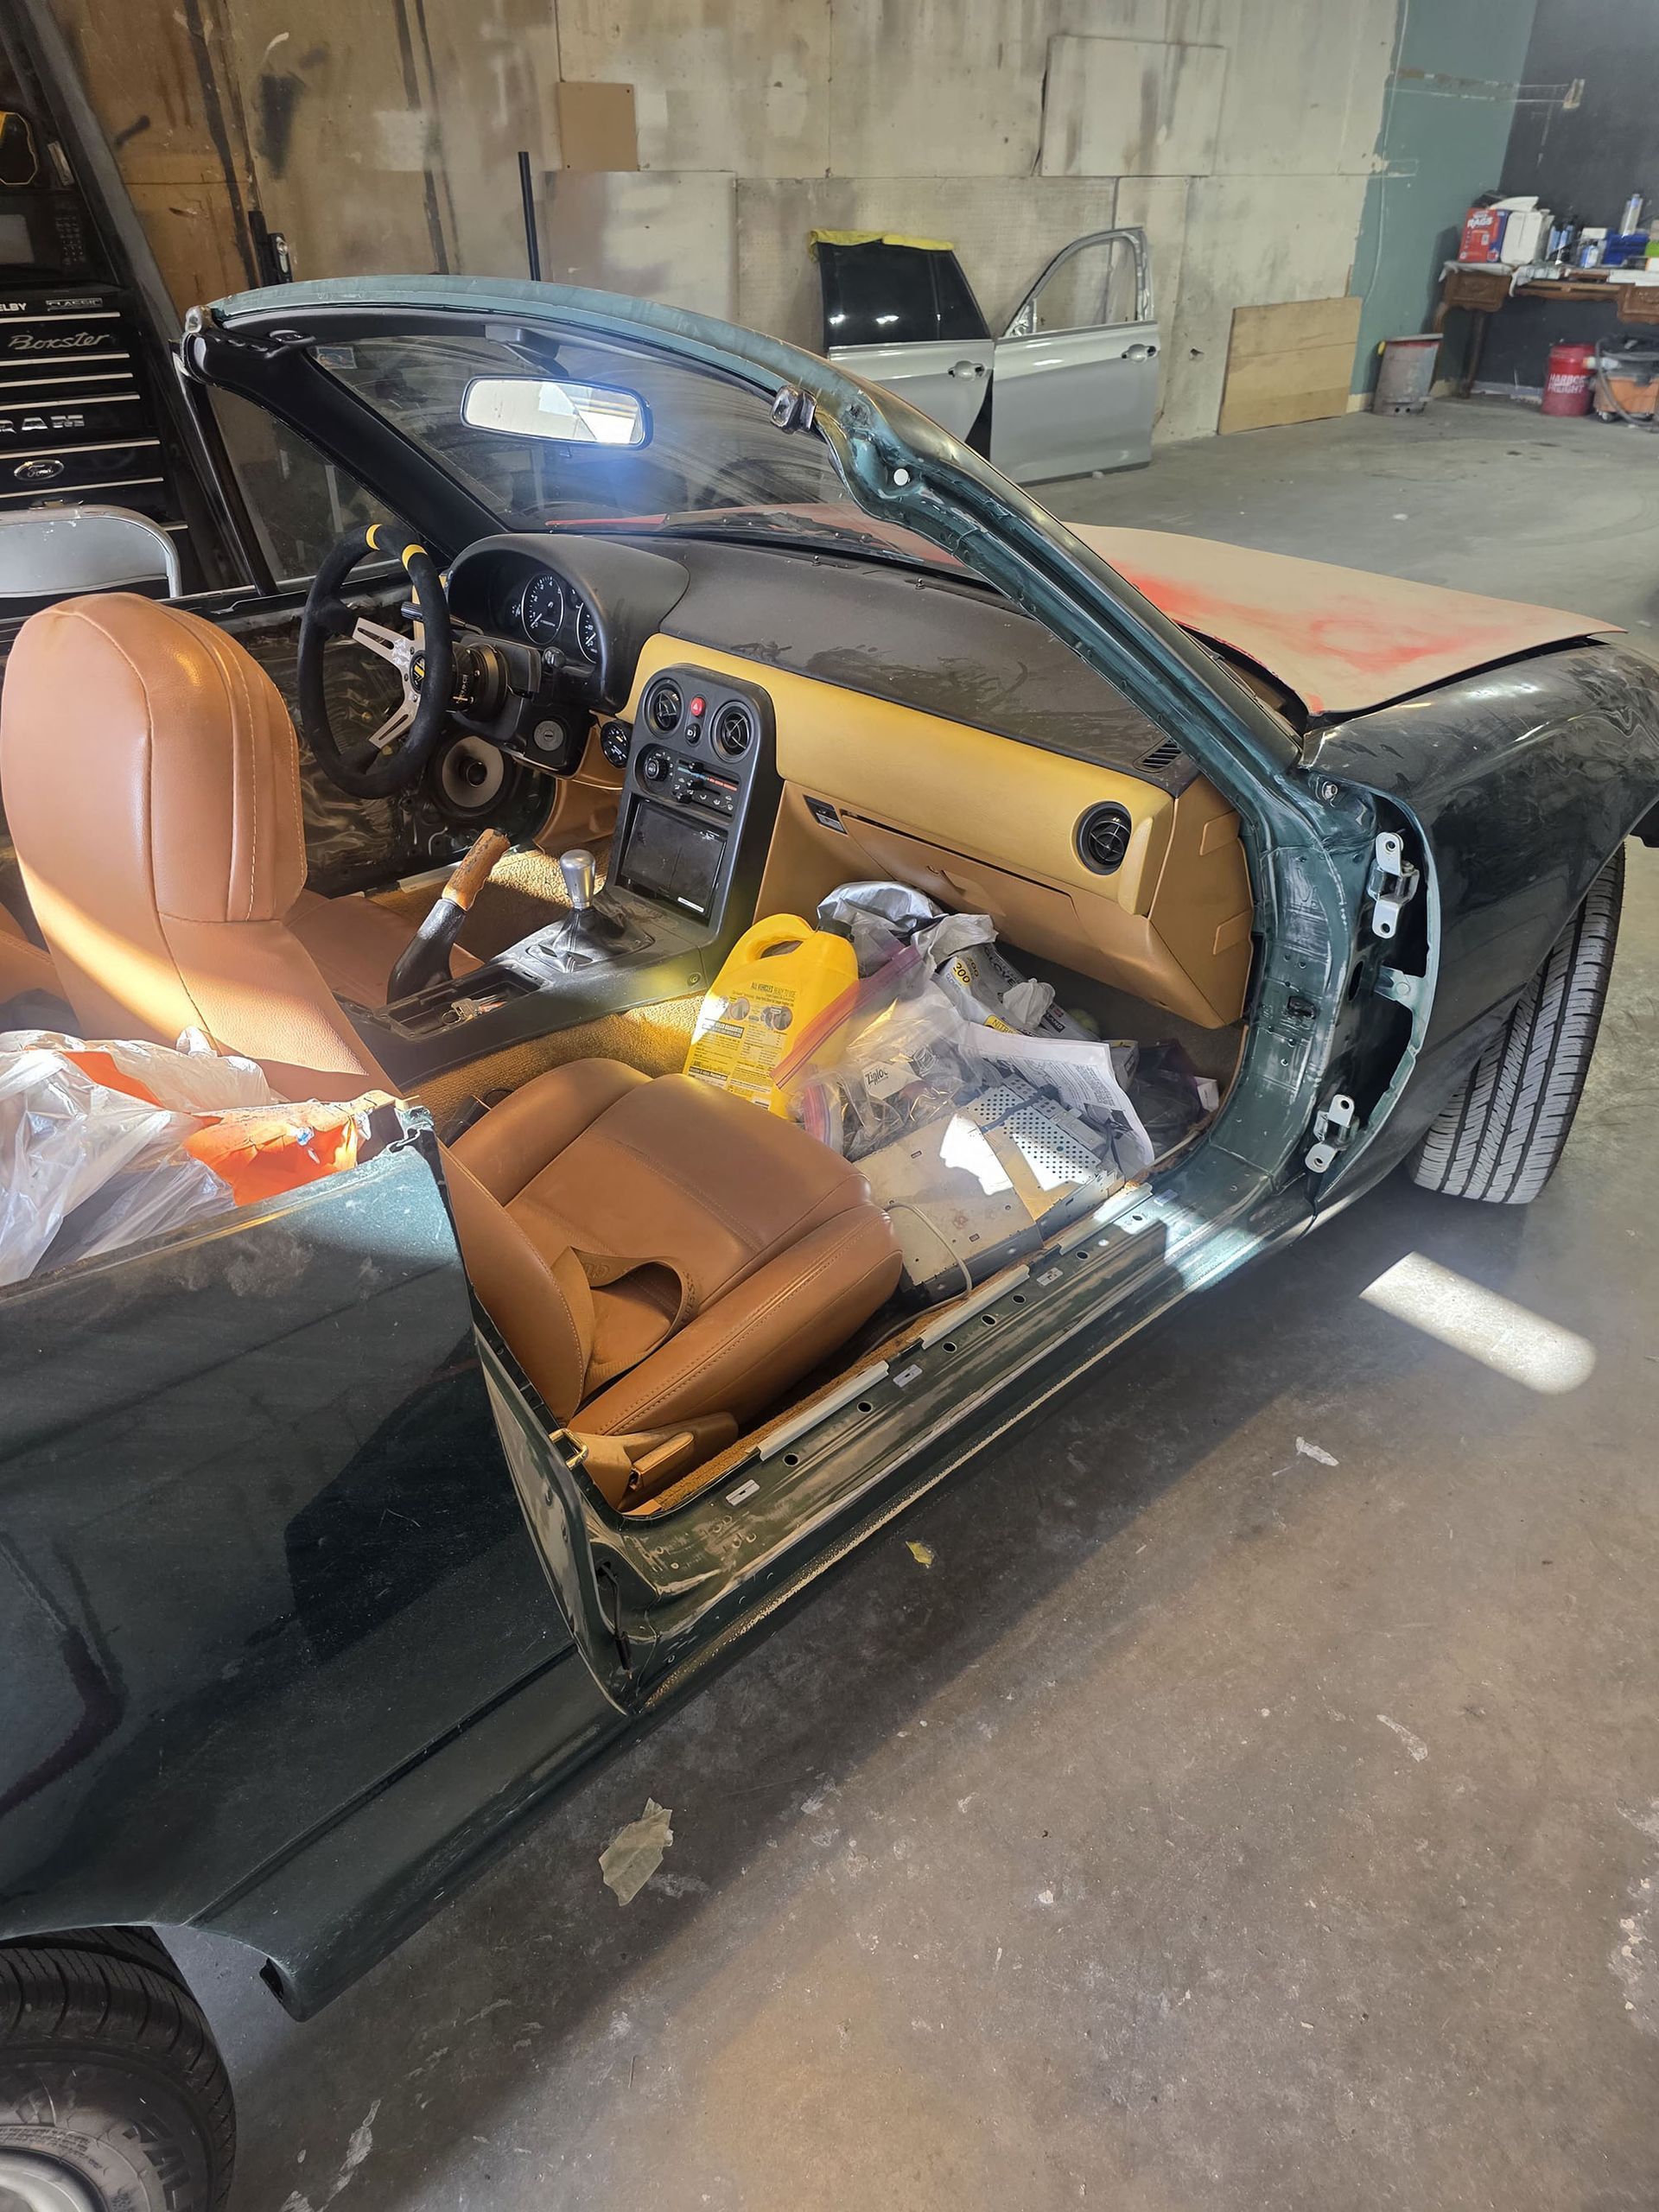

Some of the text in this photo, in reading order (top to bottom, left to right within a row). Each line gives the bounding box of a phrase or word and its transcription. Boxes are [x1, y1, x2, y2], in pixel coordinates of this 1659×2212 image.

[9, 332, 110, 350] Boxster
[0, 415, 85, 434] RAM
[27, 464, 54, 478] Ford
[953, 963, 970, 983] 200
[983, 947, 1017, 986] GLOVE
